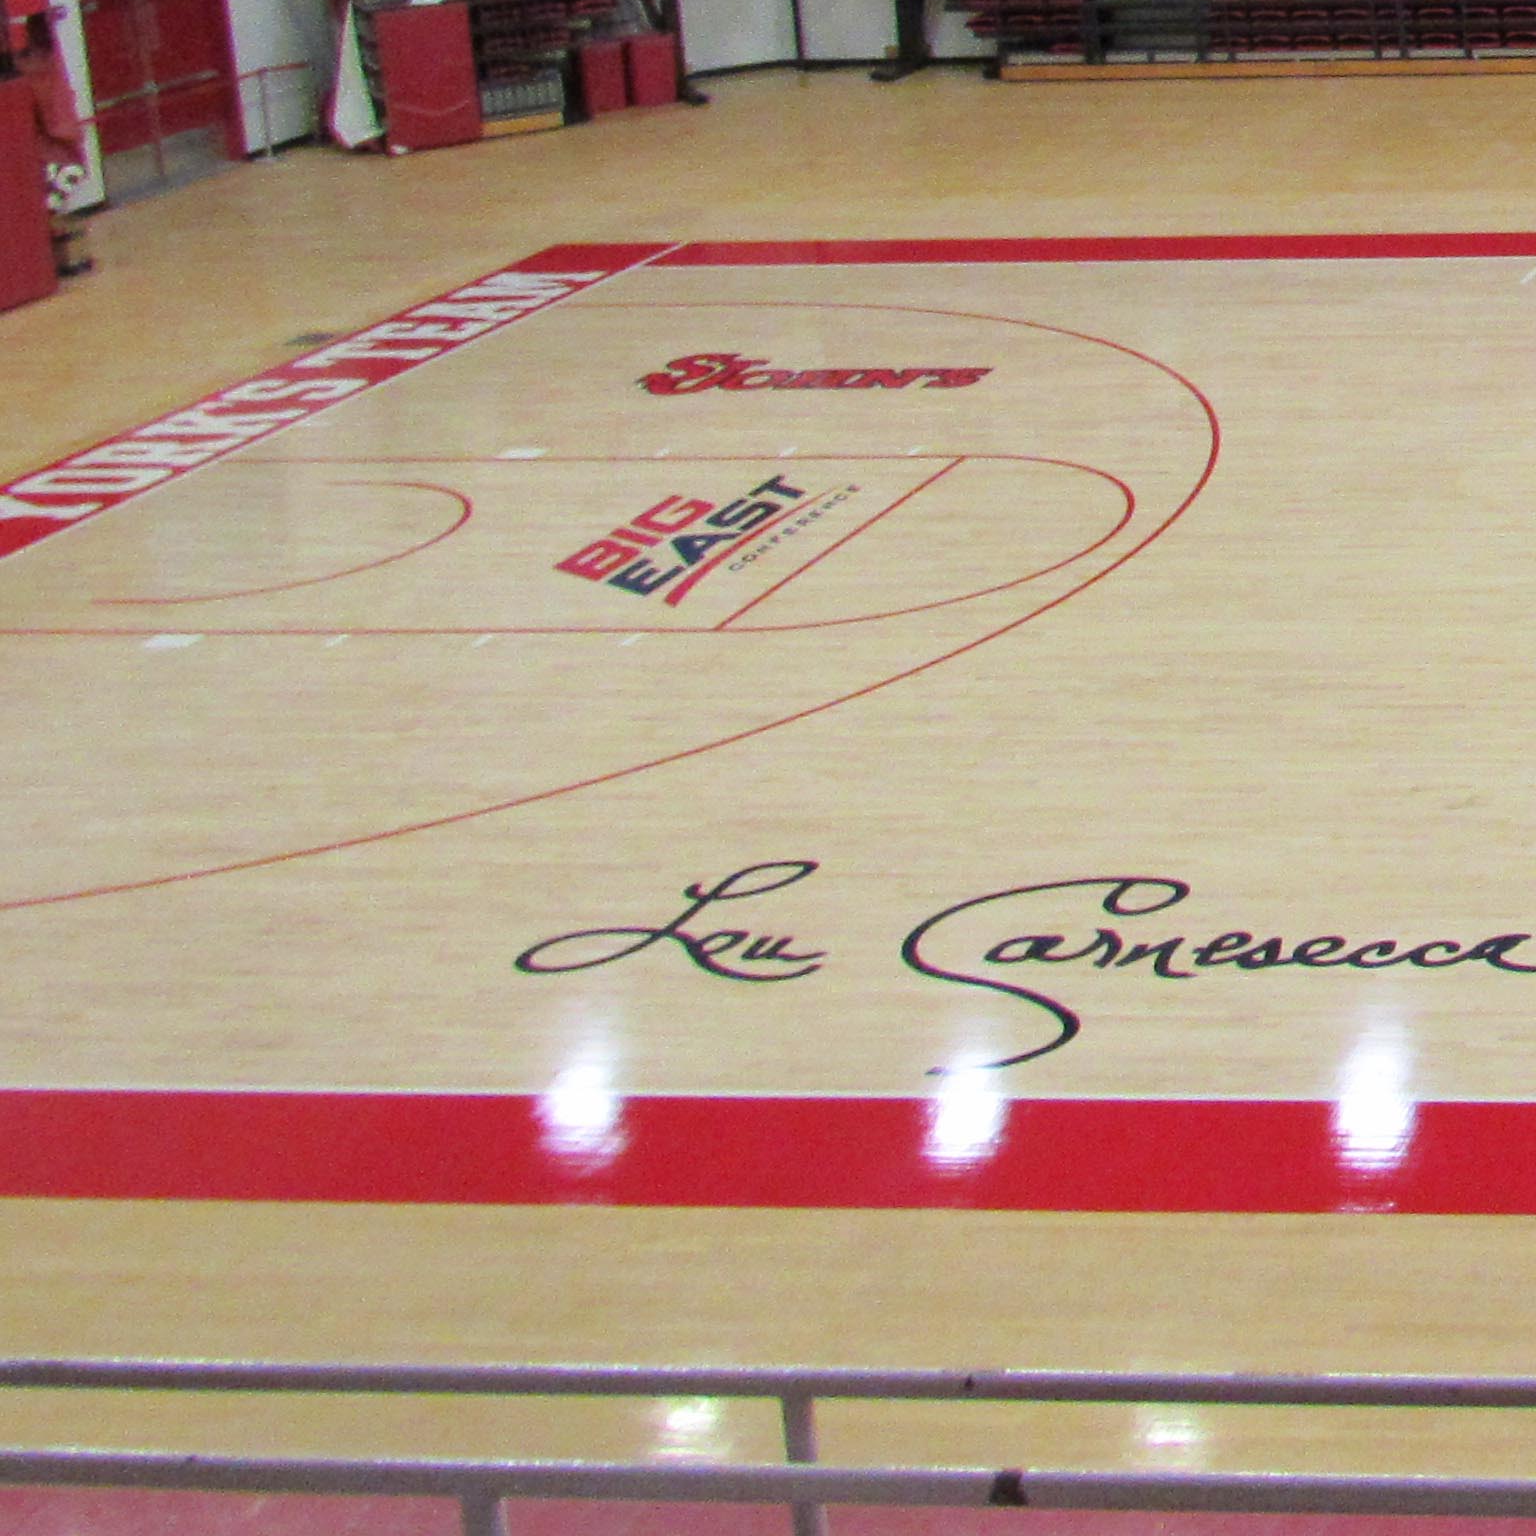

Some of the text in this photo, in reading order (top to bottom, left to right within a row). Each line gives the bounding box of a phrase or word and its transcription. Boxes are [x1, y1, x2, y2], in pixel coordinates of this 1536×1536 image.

[293, 270, 609, 368] TEAM
[552, 494, 716, 581] BIG
[607, 475, 809, 596] EAST
[728, 483, 862, 572] CONFERENCE
